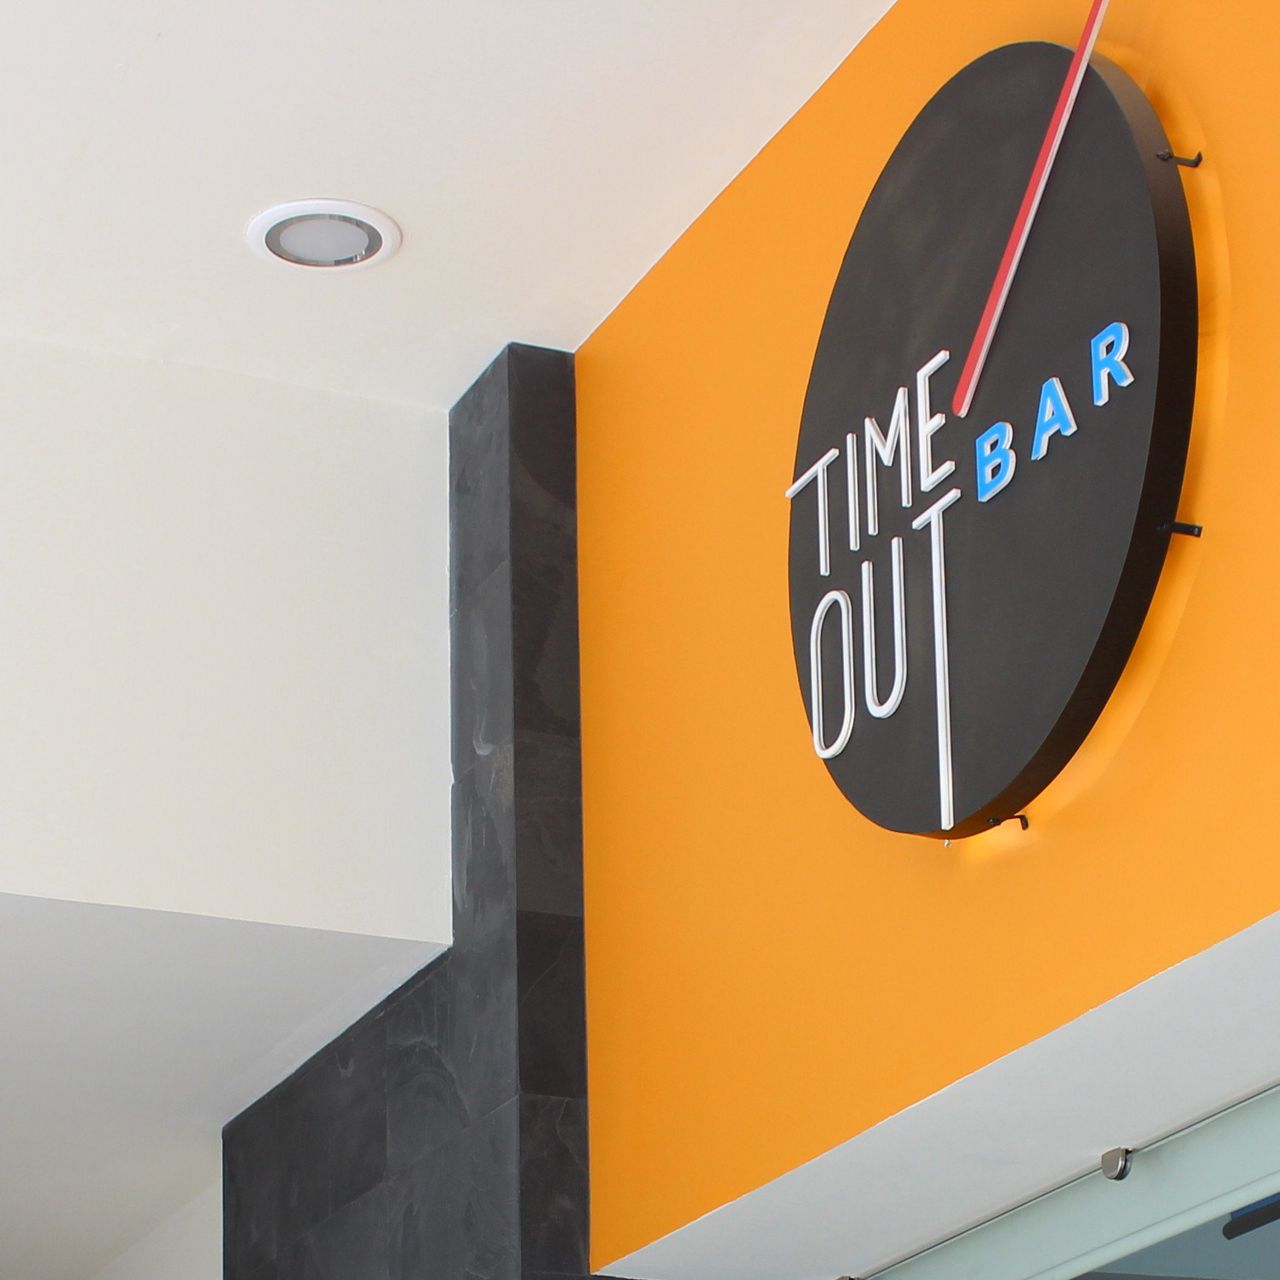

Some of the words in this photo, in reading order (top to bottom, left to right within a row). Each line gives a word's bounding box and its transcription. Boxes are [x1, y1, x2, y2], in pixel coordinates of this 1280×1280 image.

[785, 348, 957, 577] TIME
[975, 320, 1135, 503] BAR
[810, 487, 962, 831] OUT
